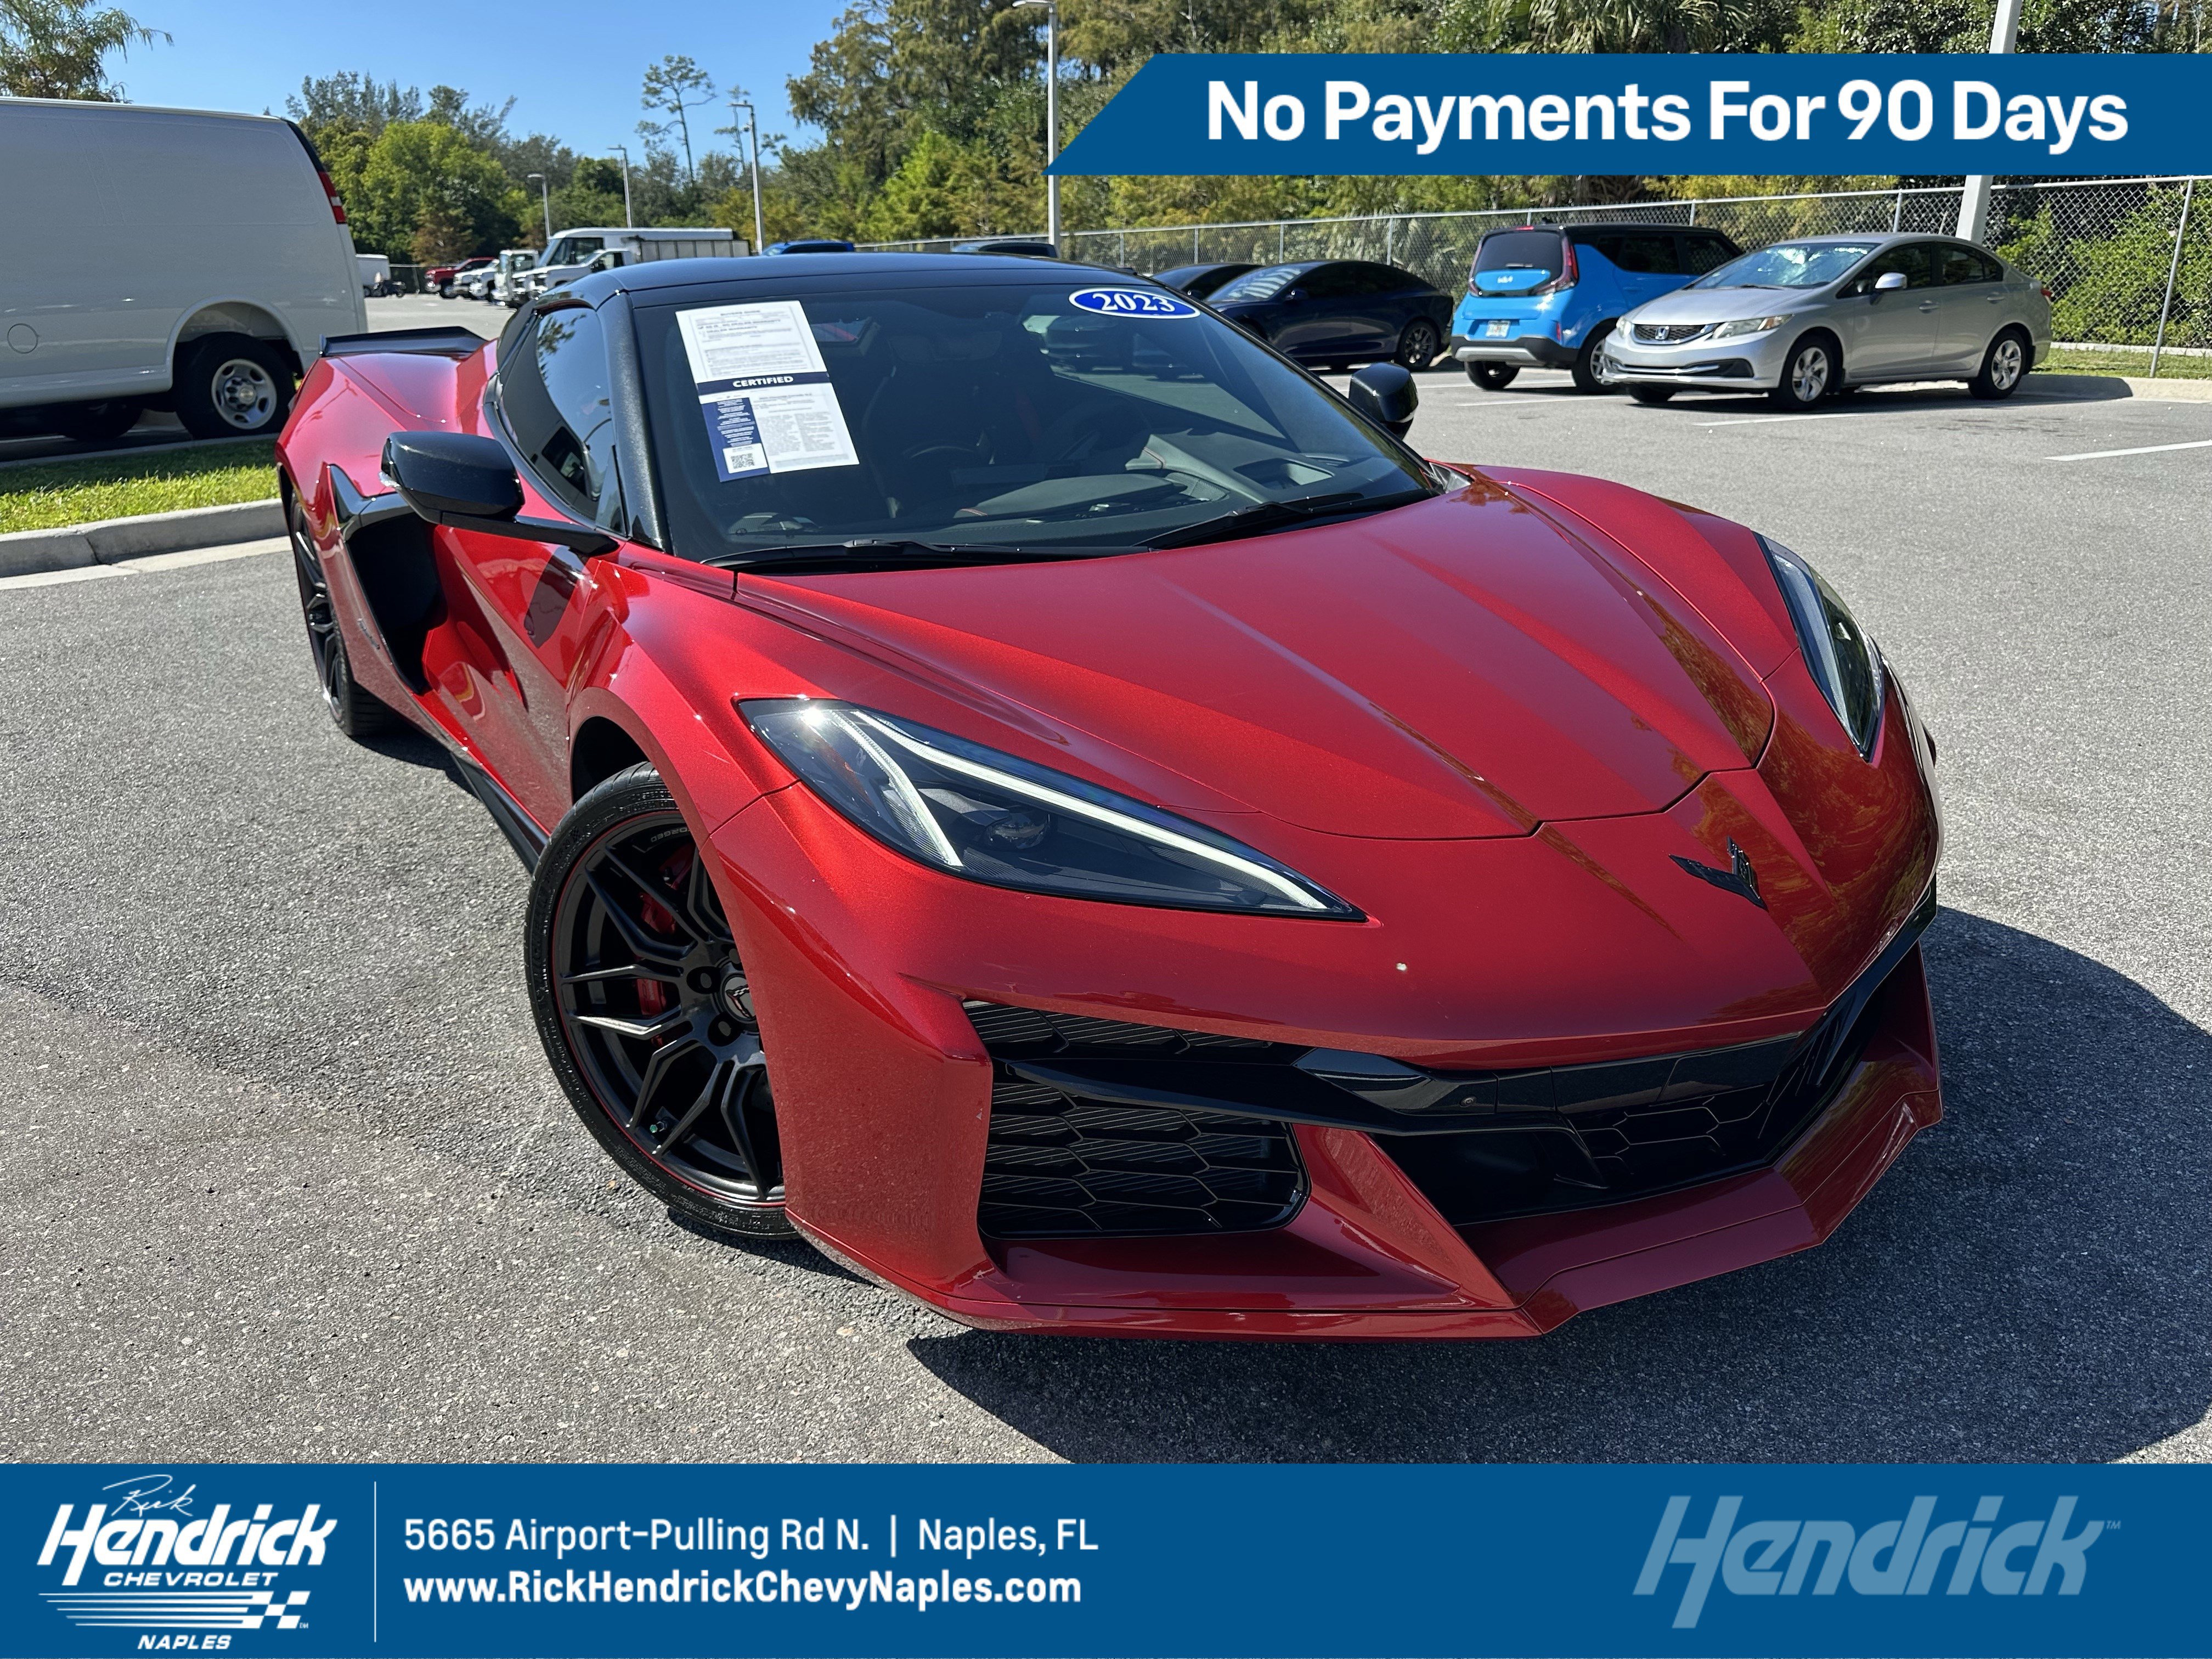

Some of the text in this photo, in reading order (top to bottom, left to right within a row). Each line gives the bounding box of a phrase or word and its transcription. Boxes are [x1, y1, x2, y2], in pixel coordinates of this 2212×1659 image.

[1092, 292, 1175, 312] 2023
[732, 375, 794, 388] CERTIFIED
[651, 827, 690, 843] ORGED
